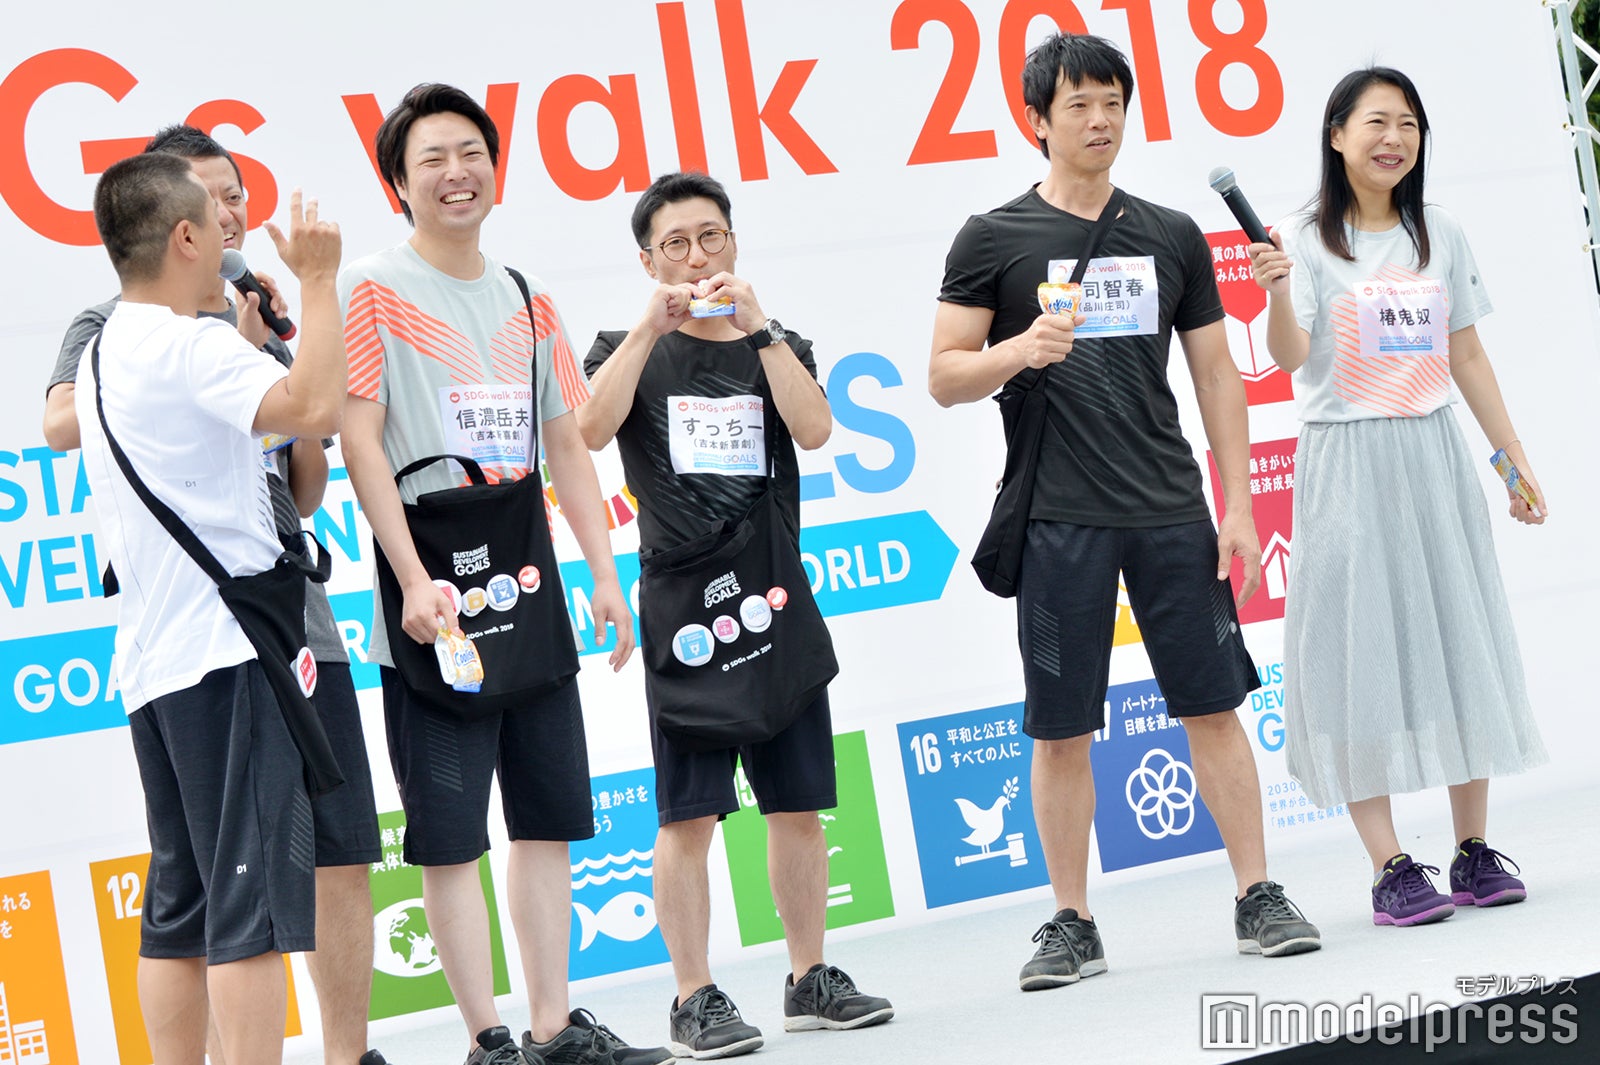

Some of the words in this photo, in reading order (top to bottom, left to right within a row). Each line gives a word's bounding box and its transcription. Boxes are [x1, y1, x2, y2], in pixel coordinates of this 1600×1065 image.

[1099, 263, 1123, 273] walk
[1126, 262, 1147, 272] 2018
[1421, 285, 1441, 294] 2018
[1103, 314, 1138, 326] GOALS
[1379, 308, 1431, 326] 椿鬼奴
[463, 391, 489, 401] SDGs
[490, 390, 511, 401] walk
[513, 391, 532, 401] 2018
[692, 402, 719, 413] SDGs
[721, 401, 745, 413] walk
[456, 407, 529, 430] 信濃岳夫
[682, 417, 763, 437] すっちー
[723, 454, 758, 463] GOALS
[454, 556, 491, 577] GOALS
[704, 582, 742, 609] GOALS
[730, 656, 747, 668] SDGs
[946, 718, 1018, 746] 平和と公正を
[910, 732, 942, 775] 16
[950, 742, 1022, 768] すべての人に
[236, 863, 247, 874] D1
[106, 871, 142, 920] 12
